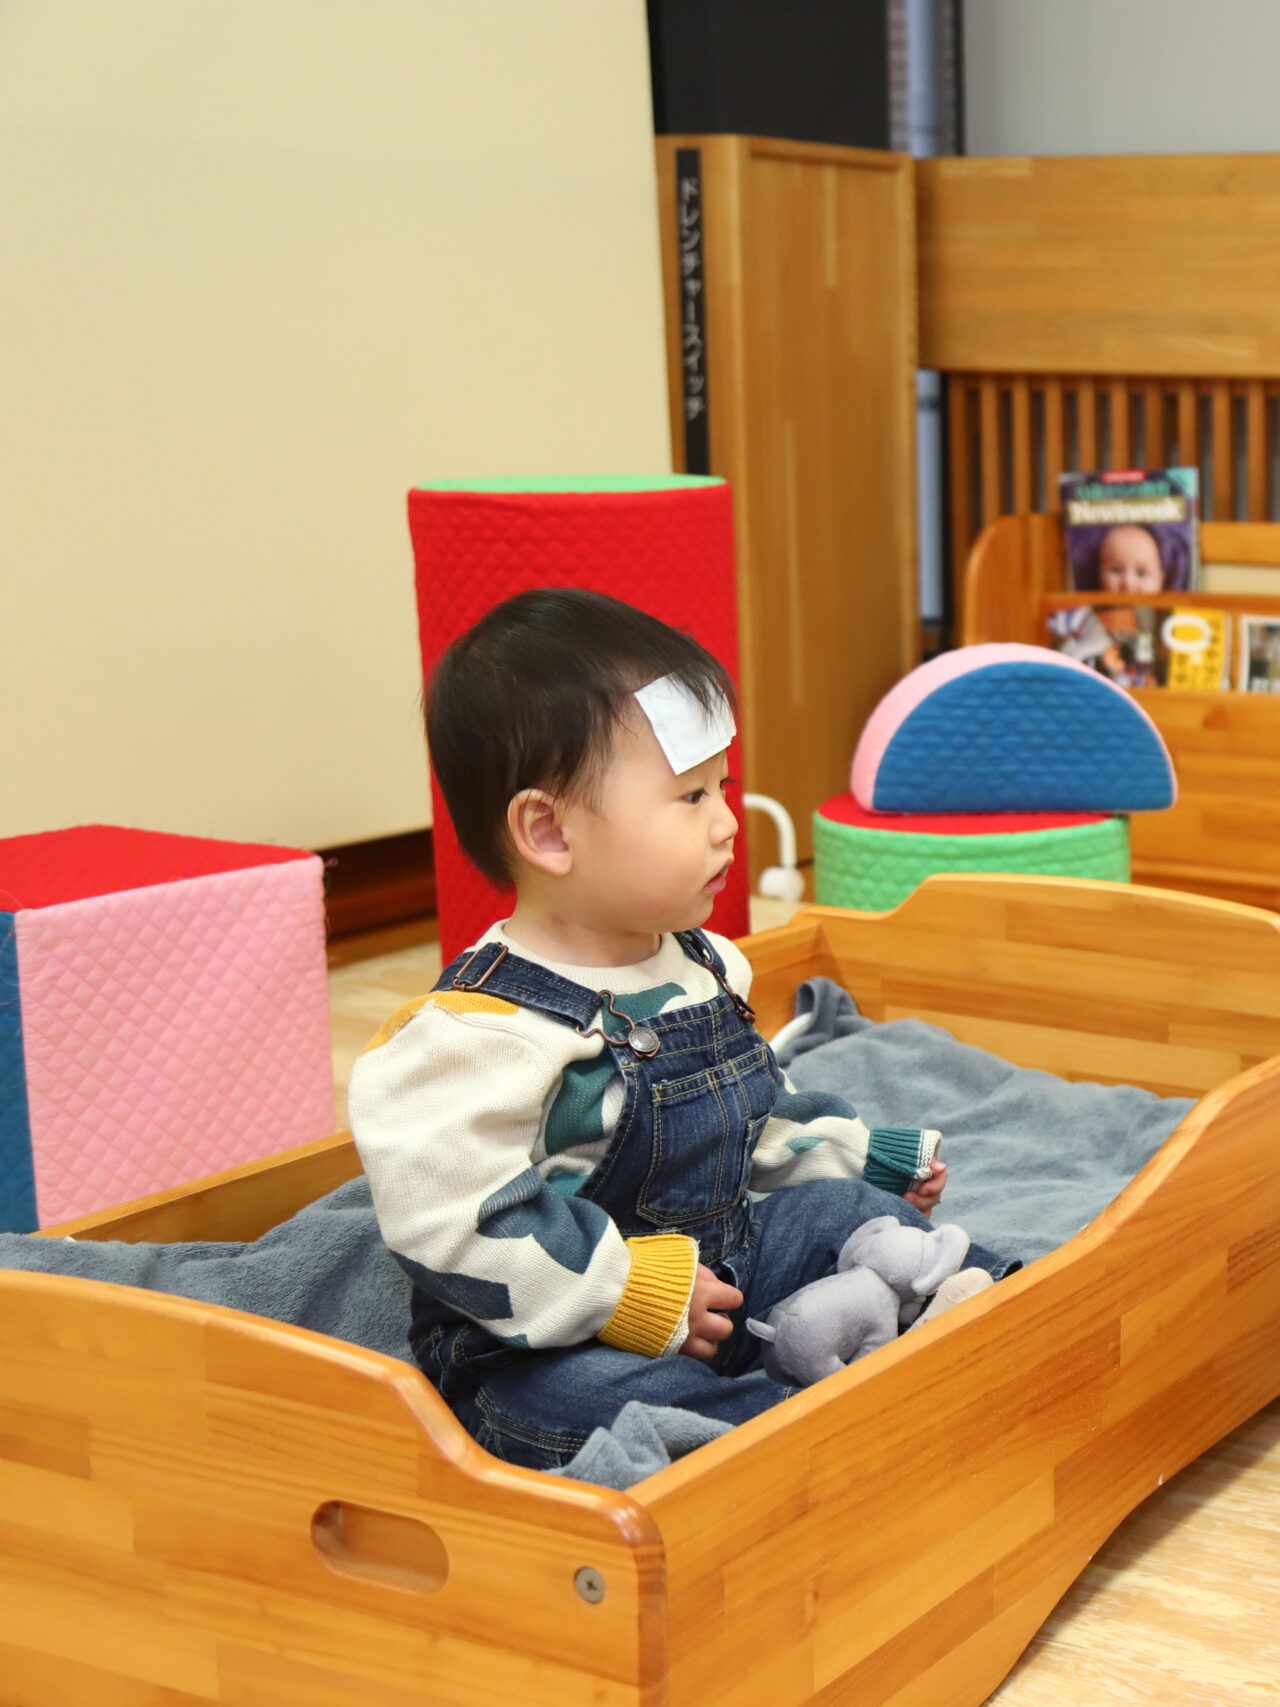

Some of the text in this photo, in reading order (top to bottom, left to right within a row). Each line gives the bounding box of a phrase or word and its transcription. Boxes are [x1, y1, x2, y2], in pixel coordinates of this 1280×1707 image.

[678, 176, 706, 421] ドレンチャースイッチ
